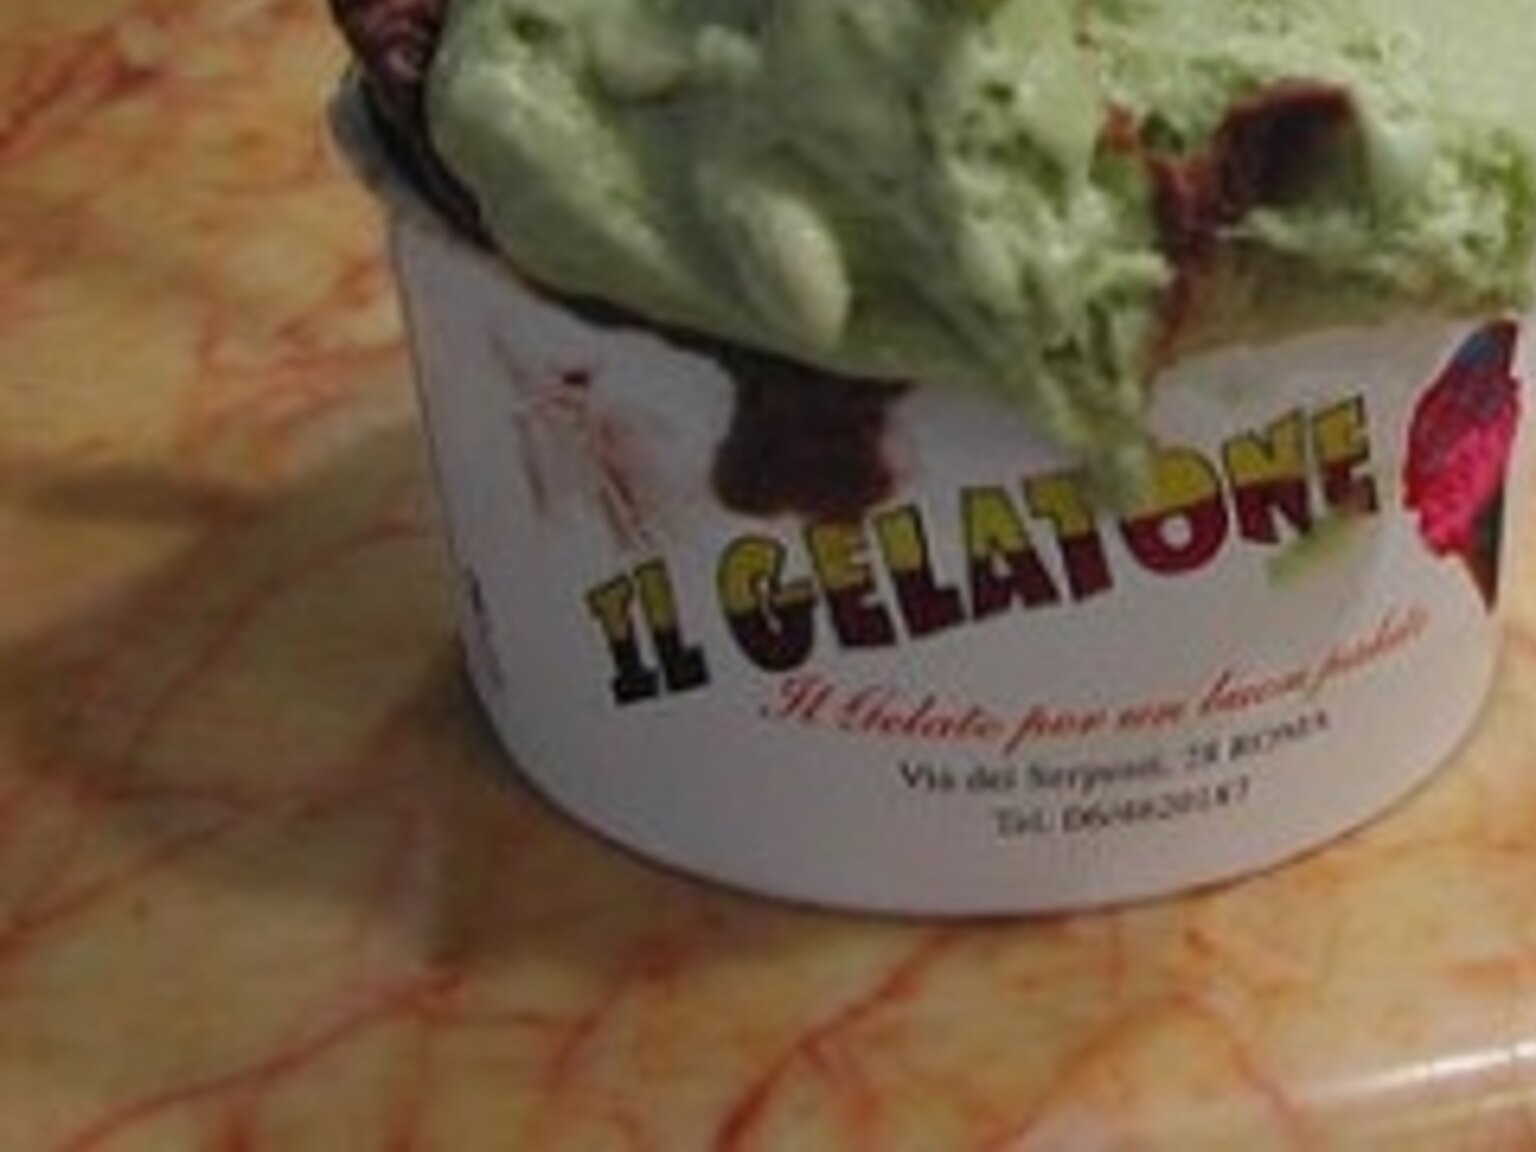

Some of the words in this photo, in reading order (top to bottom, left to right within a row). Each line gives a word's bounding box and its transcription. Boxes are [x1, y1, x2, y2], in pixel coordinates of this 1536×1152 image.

[585, 557, 709, 705] IL
[716, 395, 1380, 672] GELATONE
[838, 686, 1001, 738] Gelato
